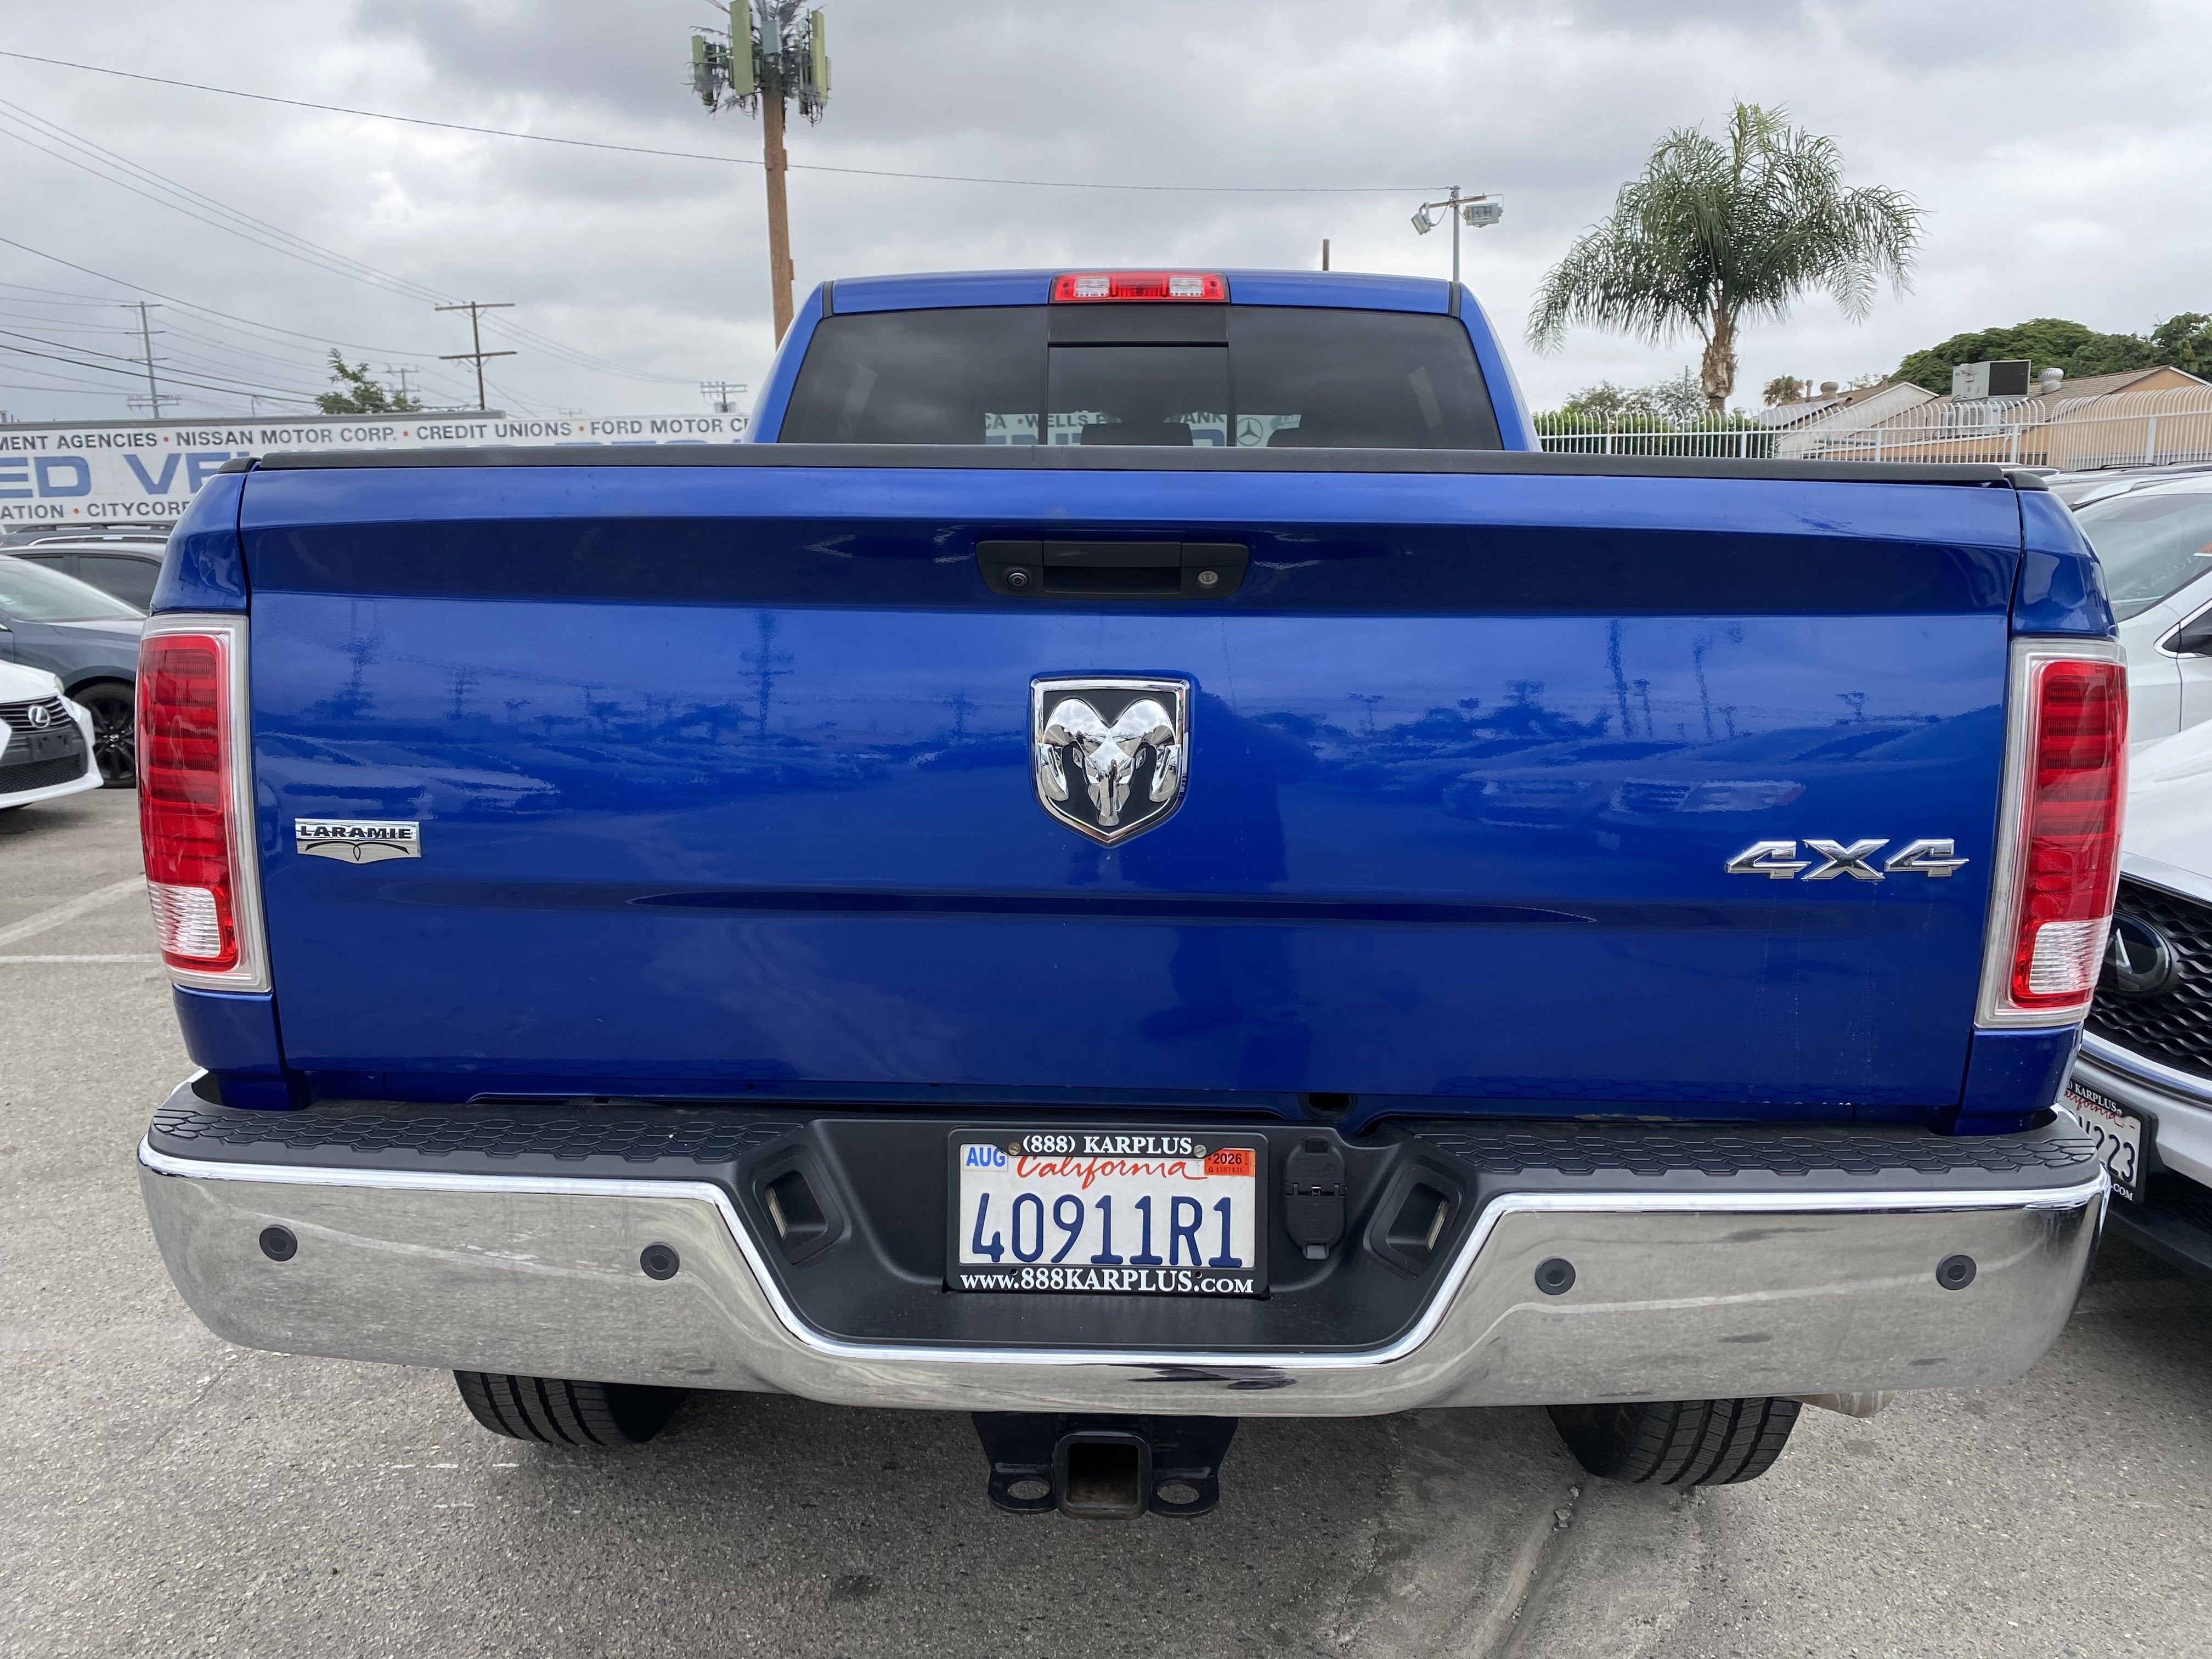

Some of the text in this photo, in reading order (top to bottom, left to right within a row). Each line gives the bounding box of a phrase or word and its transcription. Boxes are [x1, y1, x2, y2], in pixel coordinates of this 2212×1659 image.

[1025, 414, 1089, 428] WELLS
[1177, 411, 1224, 424] ANK
[176, 426, 397, 446] NISSAN MOTOR CORP.
[417, 422, 571, 440] CREDIT UNIONS
[591, 420, 642, 436] FORD
[650, 419, 723, 434] MOTOR
[57, 433, 157, 449] AGENCIES
[123, 452, 250, 494] VE
[0, 505, 64, 520] ATION
[301, 826, 411, 839] LARAMIE
[1725, 838, 1970, 880] 4X4
[2075, 1084, 2117, 1111] KARPLUS
[1023, 1136, 1192, 1155] (888) KARPLUS
[2069, 1110, 2135, 1182] 223
[966, 1147, 1006, 1167] AUG
[1213, 1153, 1242, 1164] 2026
[1017, 1155, 1208, 1190] California
[972, 1193, 1243, 1268] 40911R1
